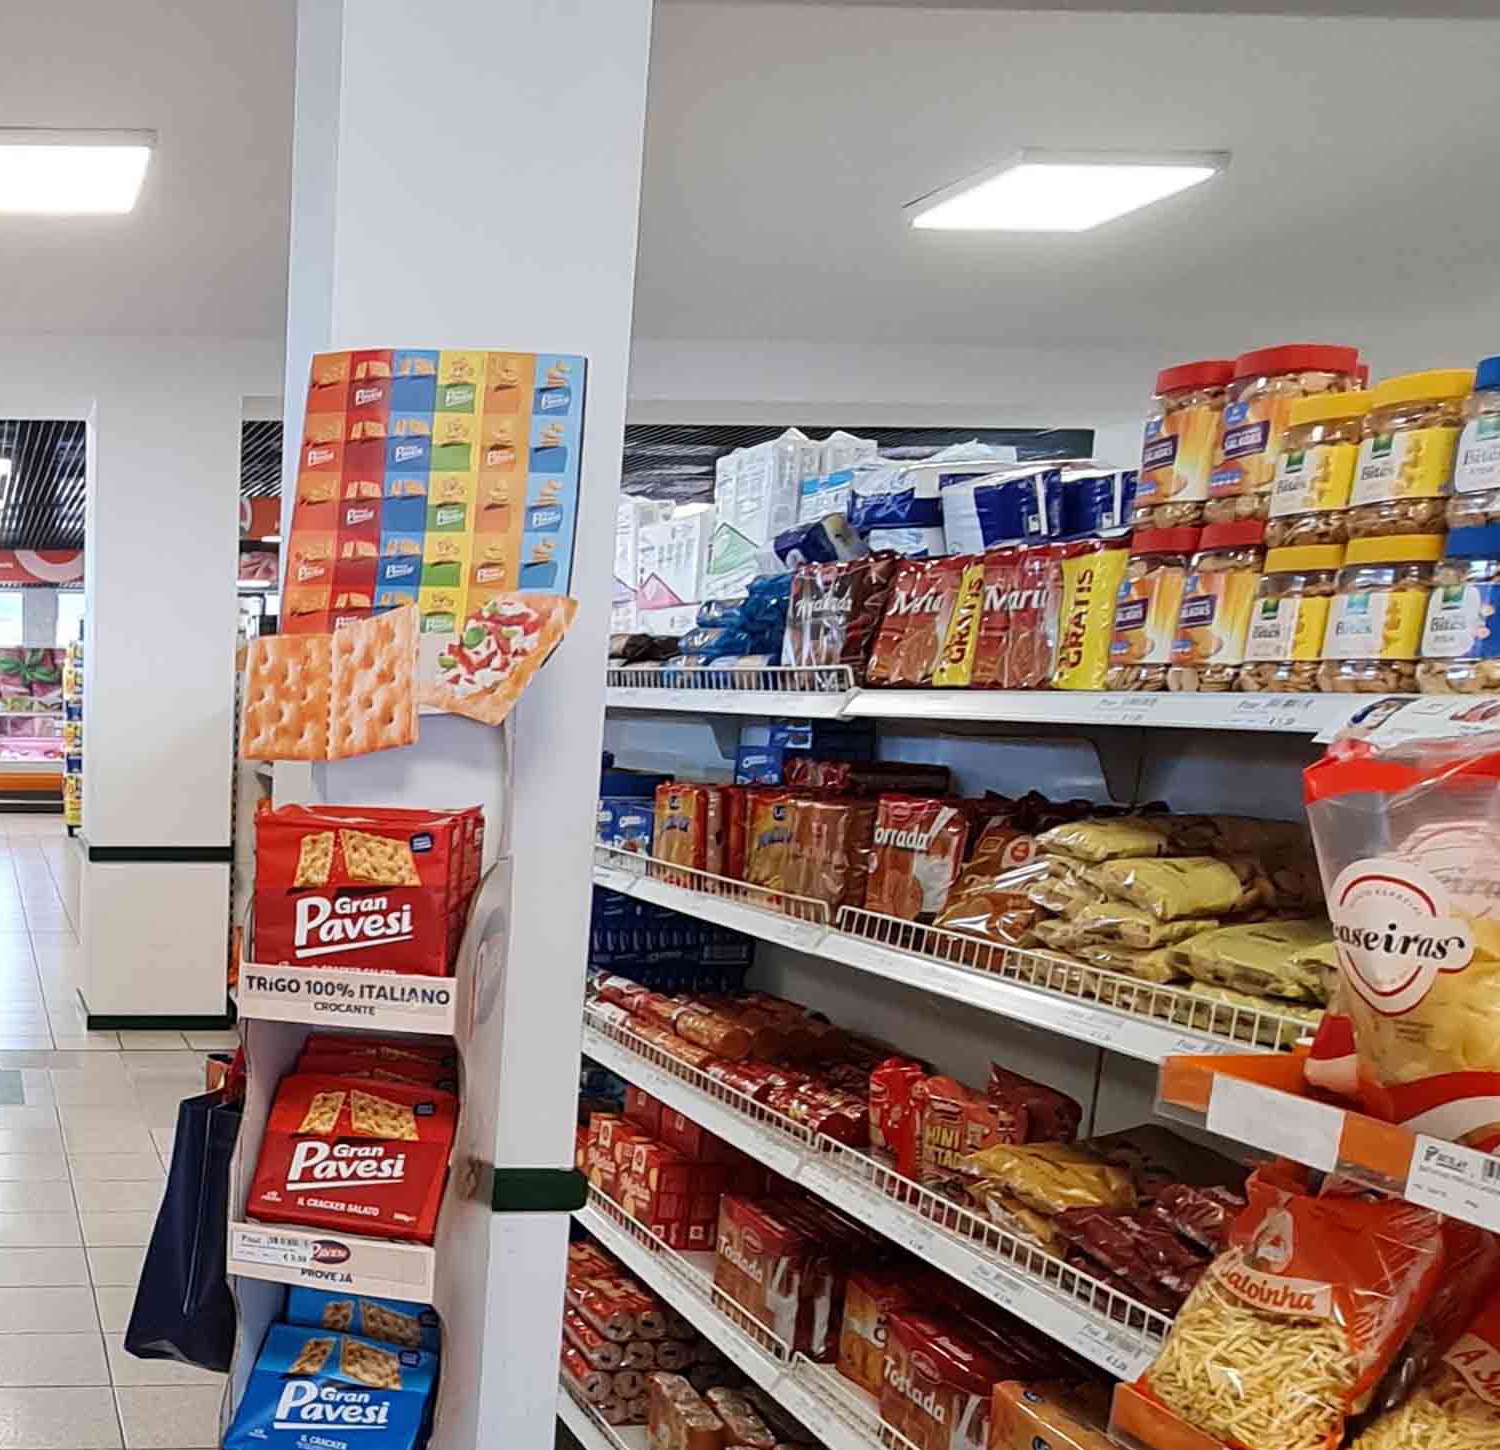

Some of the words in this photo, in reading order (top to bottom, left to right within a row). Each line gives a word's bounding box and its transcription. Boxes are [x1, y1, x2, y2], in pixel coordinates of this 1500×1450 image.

[1067, 568, 1094, 667] GRATIS
[874, 821, 932, 851] orrada
[294, 896, 414, 948] Pavesi
[334, 896, 388, 914] Gran
[305, 980, 355, 998] 100%
[359, 984, 451, 1006] ITALIANO
[313, 1001, 376, 1016] CROCANTE
[287, 1140, 406, 1181] Pavesi
[332, 1143, 385, 1158] Gran
[718, 1236, 765, 1284] Tostada
[1220, 1271, 1316, 1310] aloinha
[275, 1380, 391, 1425] Pavesi
[320, 1386, 371, 1403] Gran
[883, 1357, 946, 1424] Tostada
